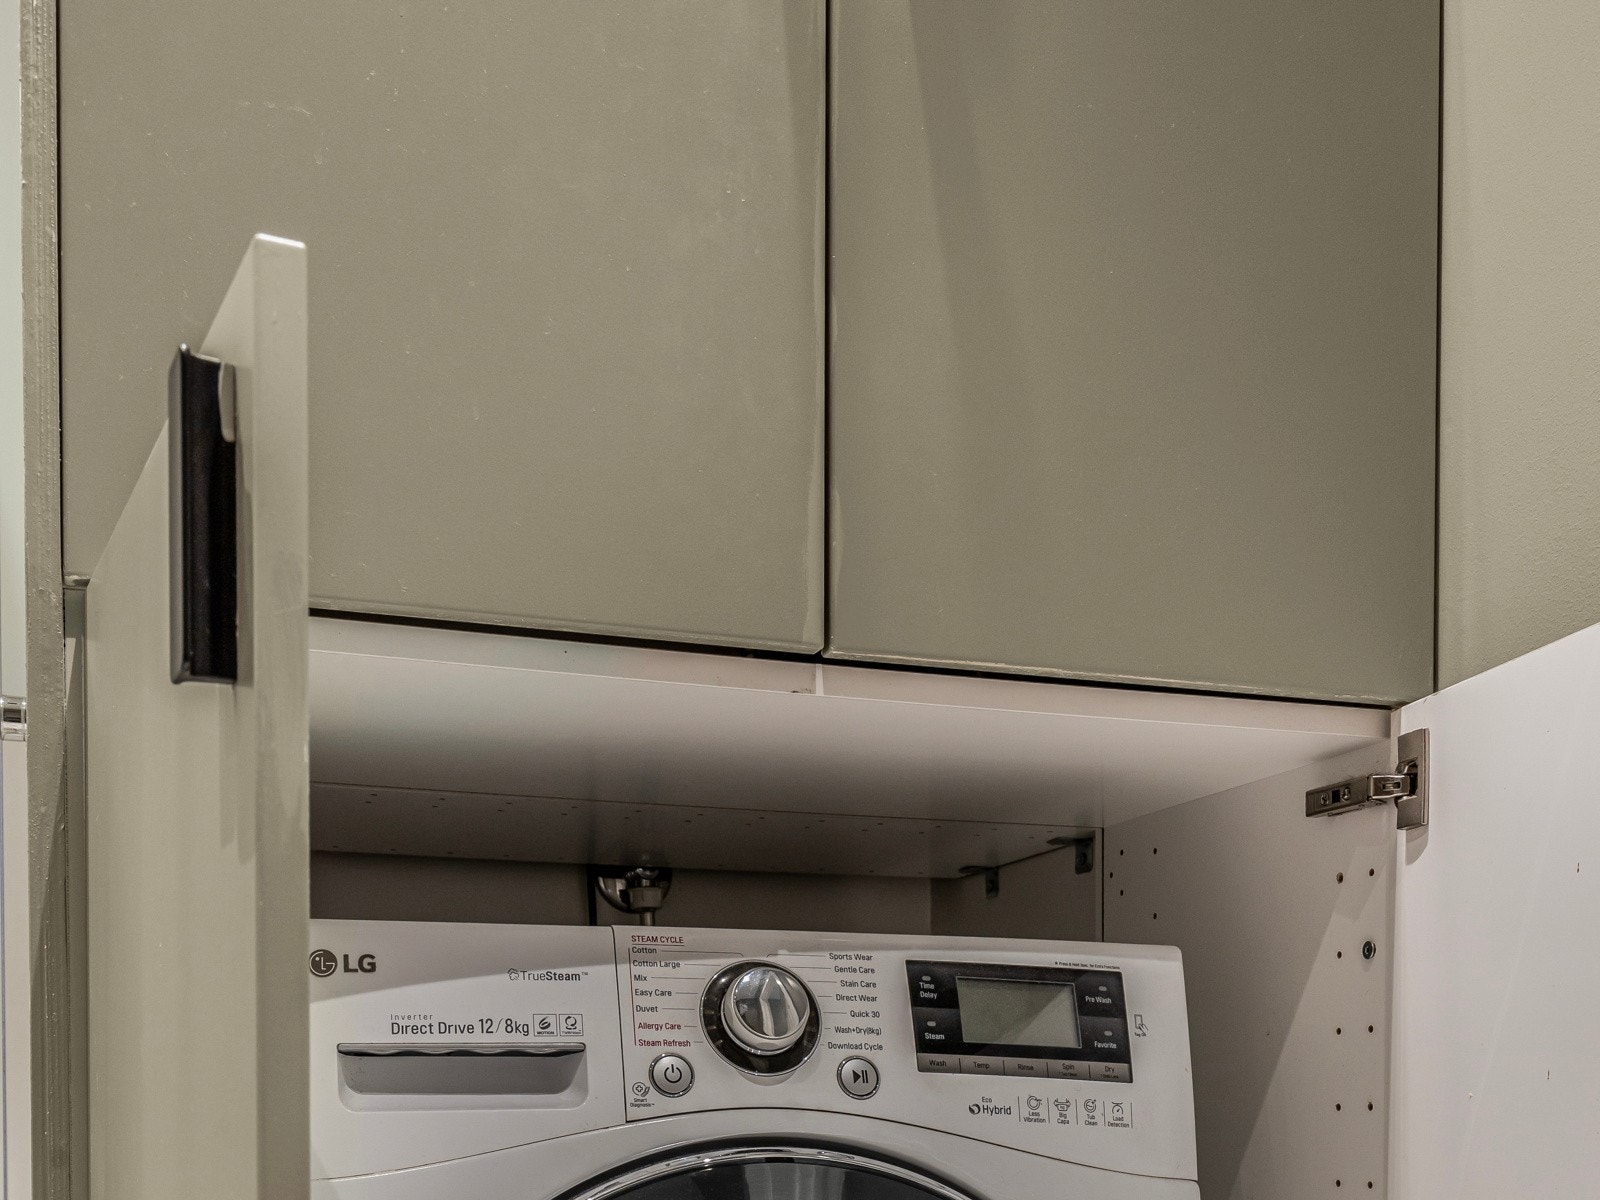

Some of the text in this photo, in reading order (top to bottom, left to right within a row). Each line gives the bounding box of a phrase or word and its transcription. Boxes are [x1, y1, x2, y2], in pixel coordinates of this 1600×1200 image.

[631, 935, 684, 944] STEAM CYCLE
[632, 946, 657, 954] Cotton
[829, 953, 853, 961] Sports
[343, 954, 377, 973] LG
[659, 960, 681, 969] Large
[834, 966, 858, 974] Gentle
[634, 974, 648, 982] Mix
[840, 980, 859, 988] Stain
[920, 982, 935, 990] Time
[634, 989, 673, 997] Easy Care
[920, 991, 938, 999] Delay
[836, 994, 858, 1002] Direct
[635, 1005, 659, 1013] Duvet
[850, 1010, 870, 1018] Quick
[391, 1022, 434, 1035] Direct
[438, 1022, 475, 1034] Drive
[637, 1022, 663, 1031] Allergy
[924, 1032, 945, 1040] Steam
[638, 1039, 662, 1047] Steam
[828, 1042, 883, 1051] Download Cycle
[1094, 1041, 1117, 1049] Favorite
[1062, 1063, 1075, 1071] Spin
[982, 1104, 1012, 1116] Hybrid
